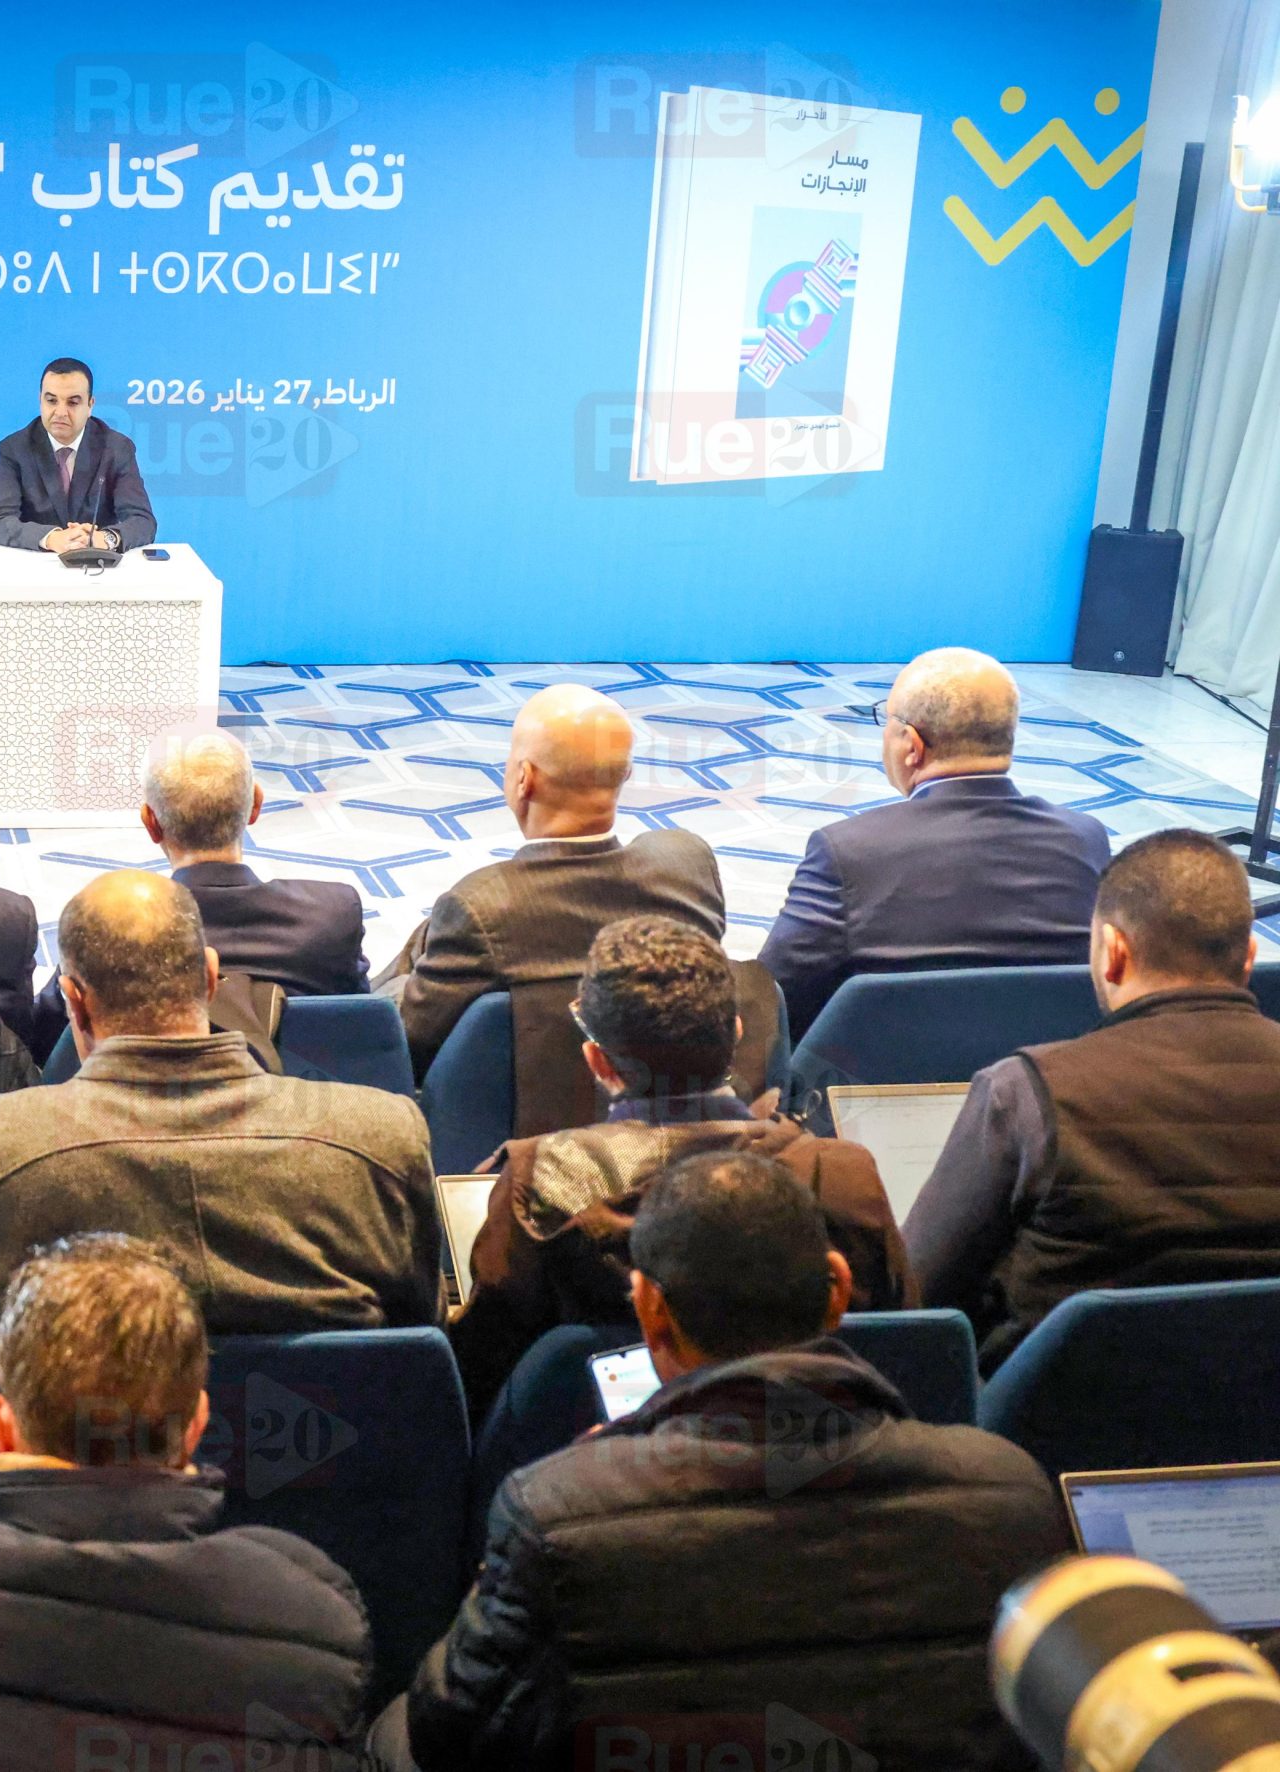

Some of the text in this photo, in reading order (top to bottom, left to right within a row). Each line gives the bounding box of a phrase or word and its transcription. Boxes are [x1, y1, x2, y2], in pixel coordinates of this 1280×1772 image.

[828, 150, 869, 170] مسار
[33, 143, 198, 227] كتاب
[209, 144, 405, 235] تقديم
[801, 173, 867, 197] الإنجازات
[127, 379, 205, 405] 2026
[210, 378, 265, 412] يناير
